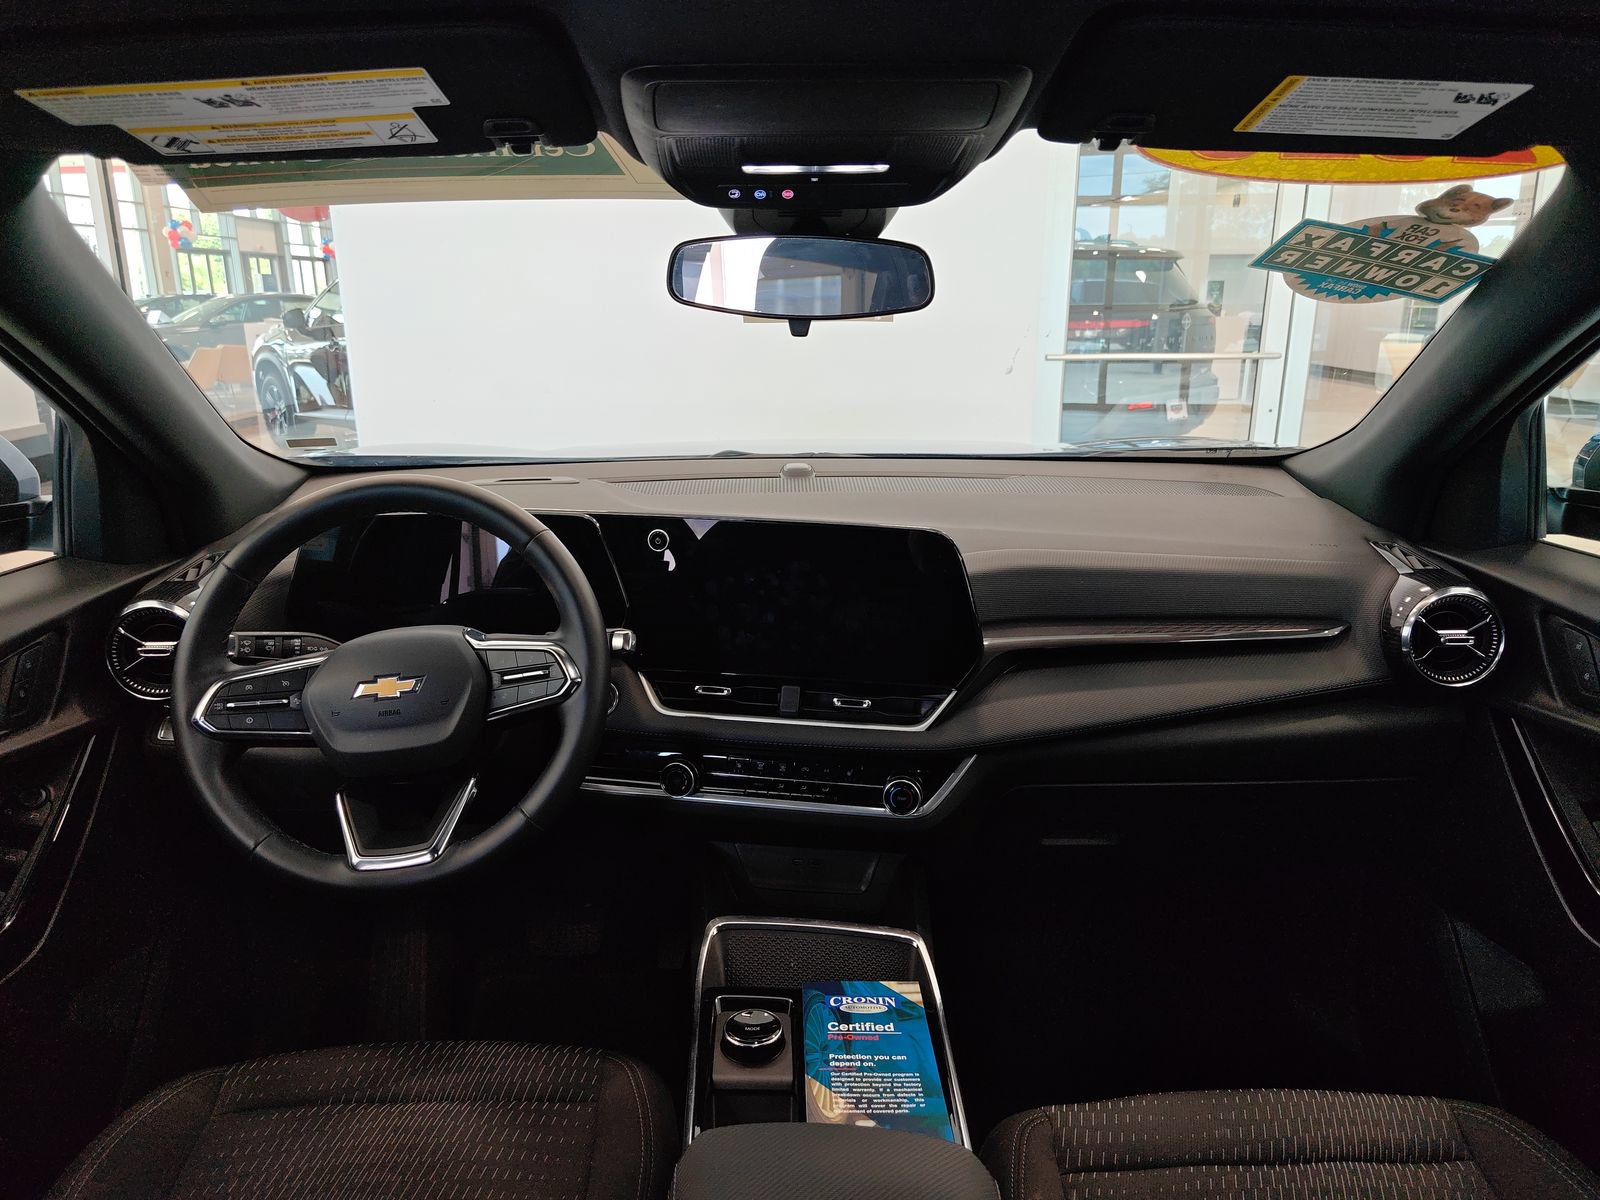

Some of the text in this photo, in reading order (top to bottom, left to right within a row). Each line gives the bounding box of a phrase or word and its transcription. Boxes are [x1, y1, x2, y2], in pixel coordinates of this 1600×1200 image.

[378, 708, 401, 717] AIRBAG
[830, 996, 895, 1008] CRONIN
[828, 1022, 894, 1031] Certified
